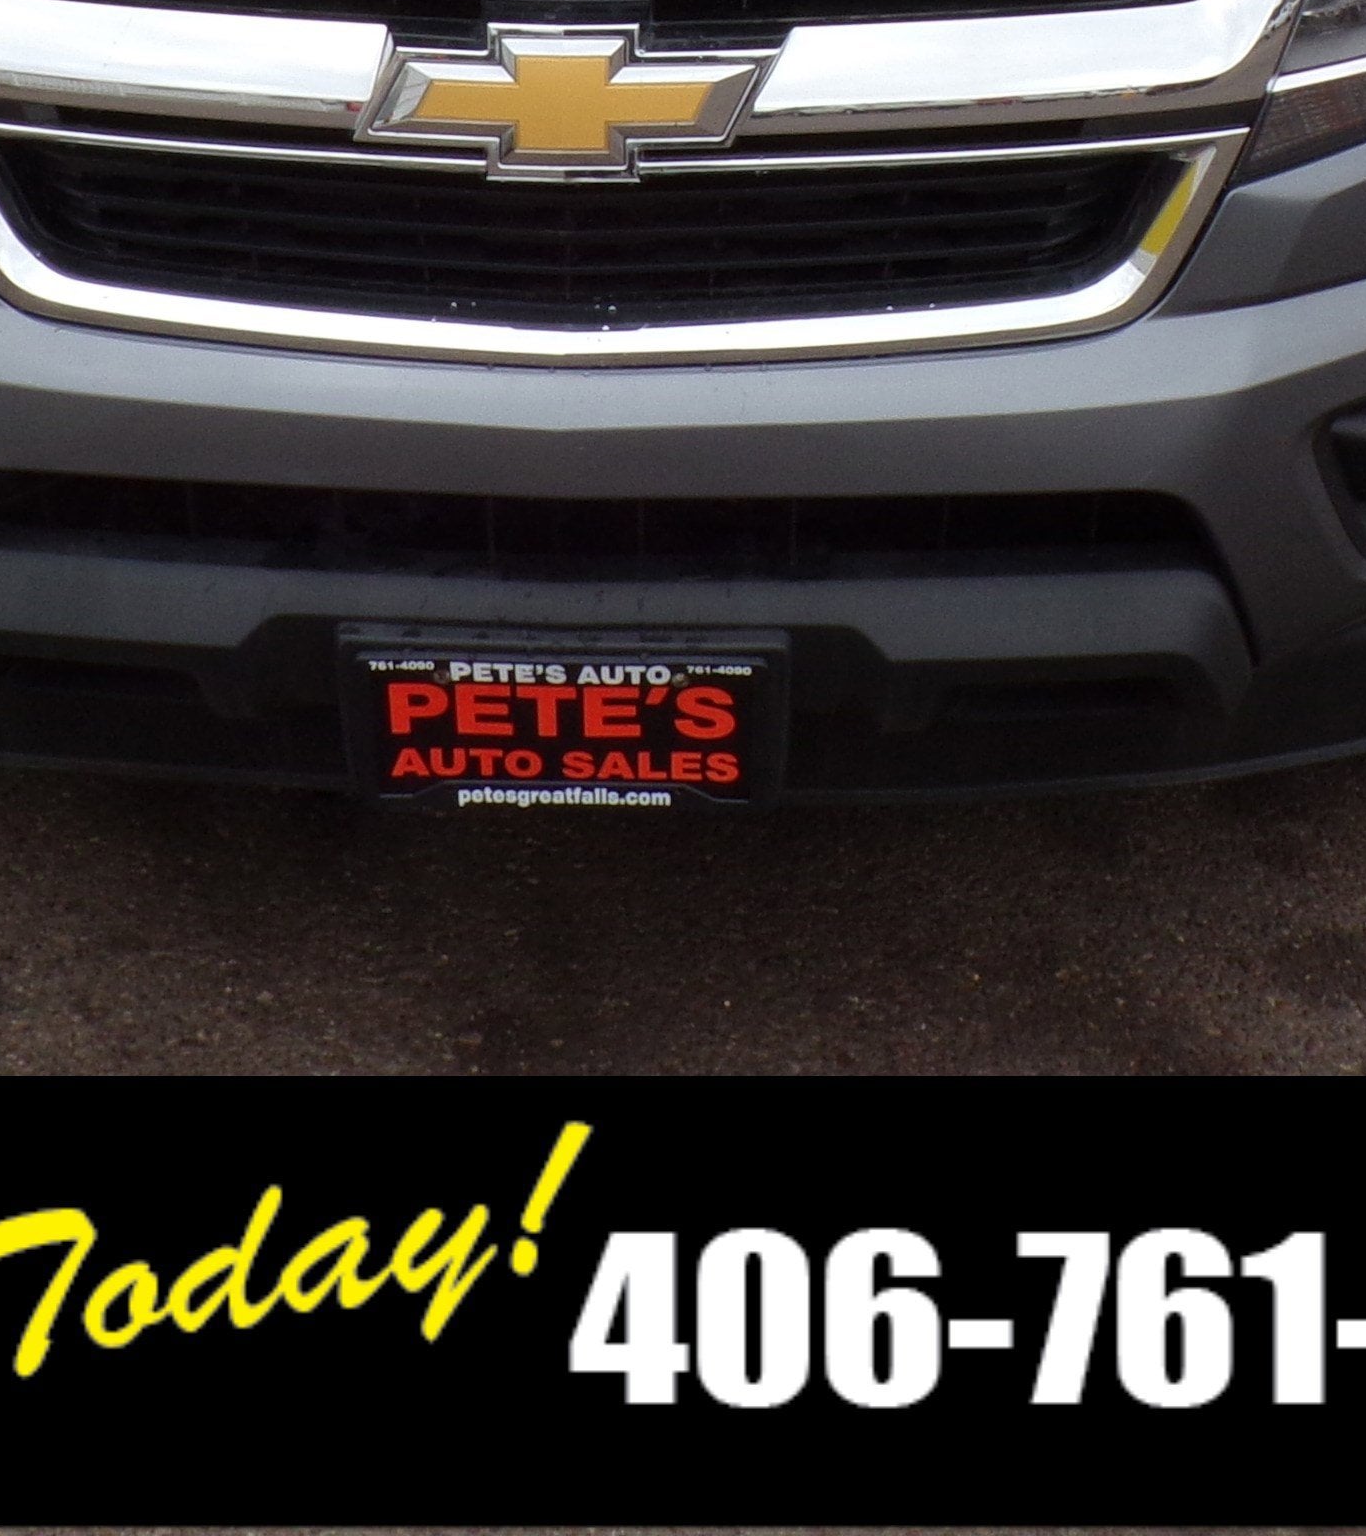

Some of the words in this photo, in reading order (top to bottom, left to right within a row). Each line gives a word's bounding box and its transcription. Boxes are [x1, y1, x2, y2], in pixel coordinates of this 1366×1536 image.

[368, 660, 435, 671] 761-4090
[449, 661, 567, 684] PETE'S
[577, 665, 671, 685] AUTO
[686, 665, 752, 676] 761-4090
[388, 682, 736, 740] PETE'S
[391, 748, 543, 779] AUTO
[562, 751, 740, 782] SALES
[458, 787, 672, 807] petesgreatfalls.com
